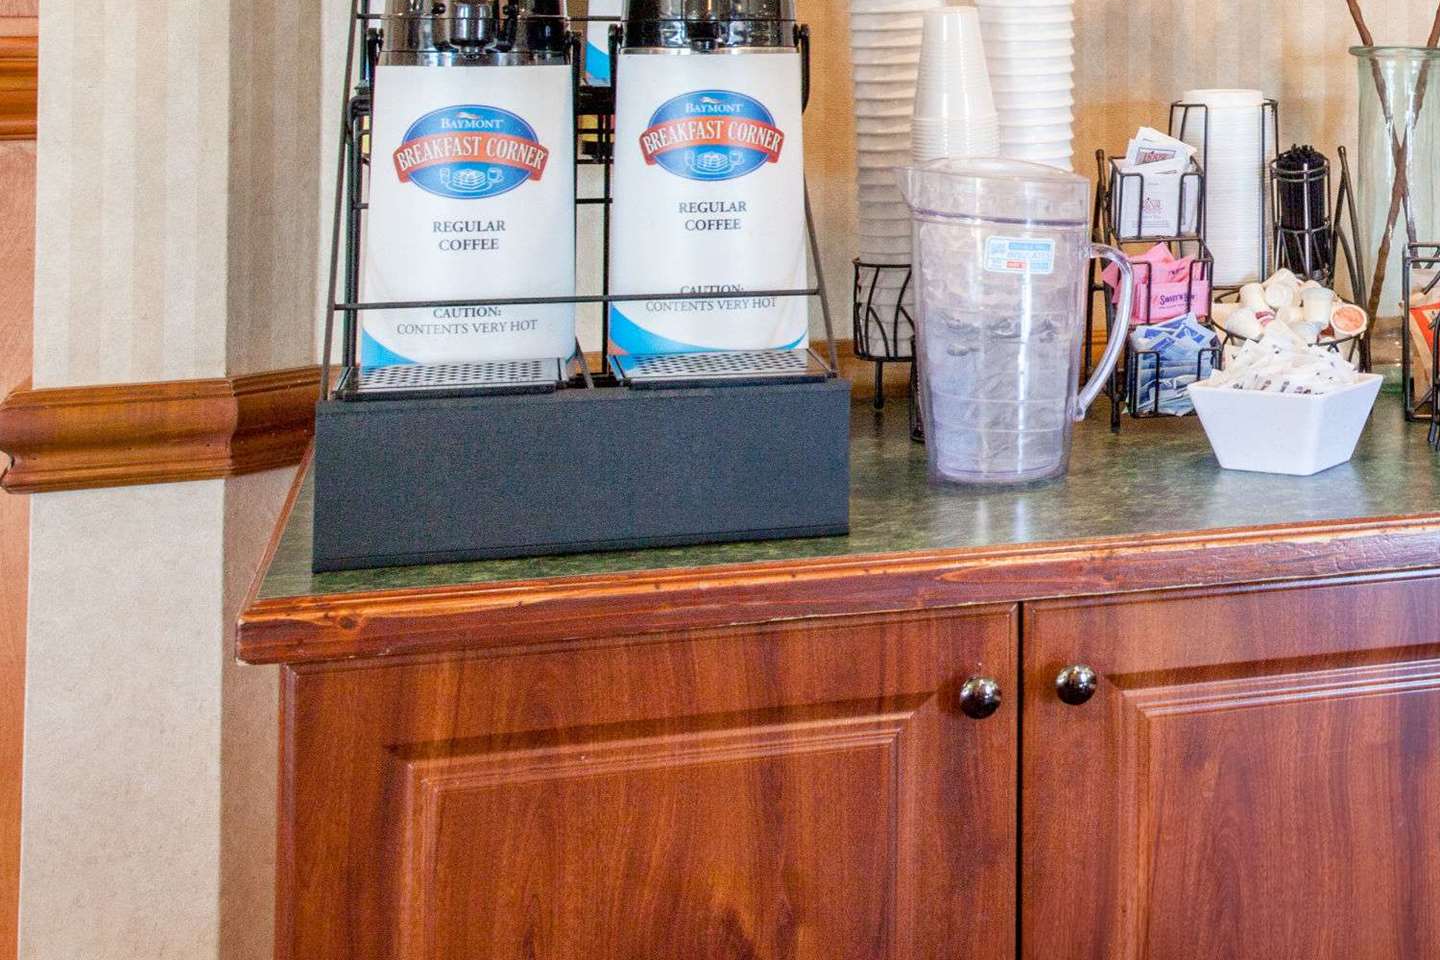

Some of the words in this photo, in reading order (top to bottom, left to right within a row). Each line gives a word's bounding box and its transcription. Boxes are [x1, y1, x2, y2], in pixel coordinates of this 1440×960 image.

[685, 103, 744, 113] BAYMONT
[441, 118, 503, 129] BAYMONT
[643, 119, 724, 154] BREAKFAST
[728, 120, 782, 153] CORNER
[396, 136, 482, 171] BREAKFAST
[486, 137, 545, 170] CORNER
[678, 201, 748, 214] REGULAR
[432, 220, 506, 233] REGULAR
[684, 218, 741, 231] COFFEE
[438, 238, 500, 251] COFFEE
[645, 300, 714, 312] CONTENTS
[717, 299, 750, 310] VERY
[752, 297, 777, 309] HOT
[432, 306, 502, 319] CAUTION:
[396, 323, 469, 335] CONTENTS
[472, 322, 508, 334] VERY
[510, 319, 538, 332] HOT
